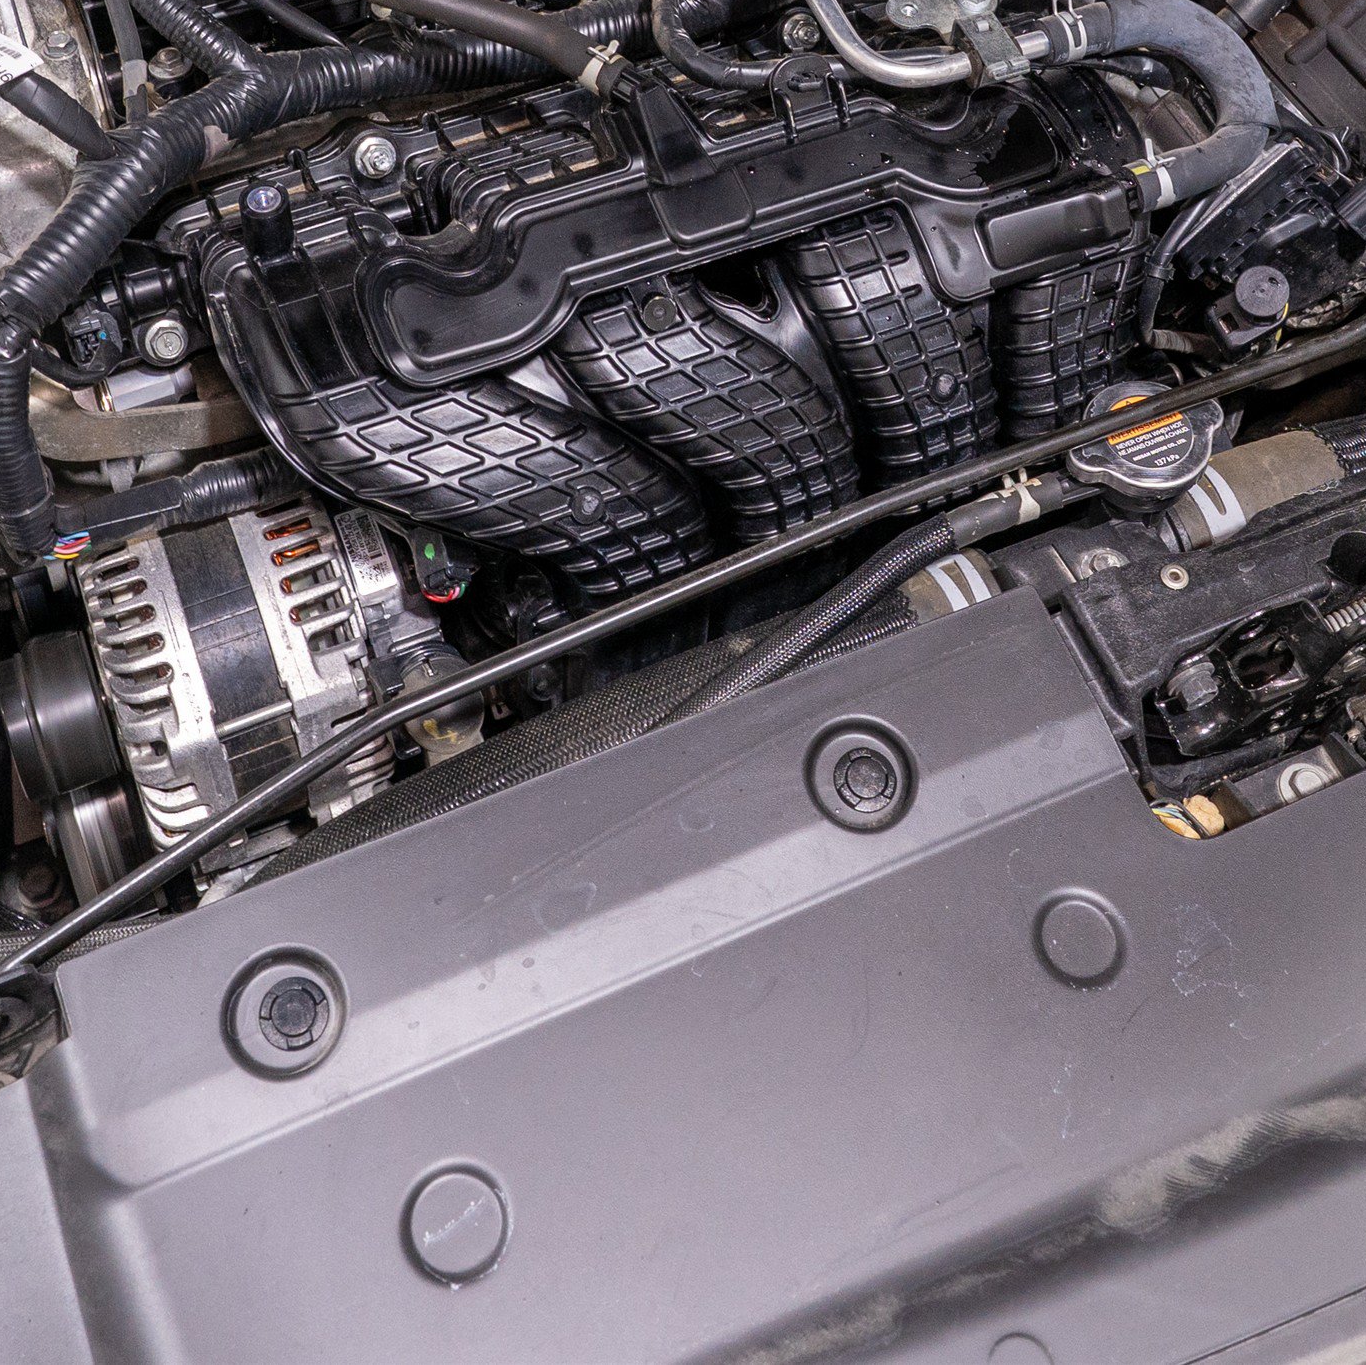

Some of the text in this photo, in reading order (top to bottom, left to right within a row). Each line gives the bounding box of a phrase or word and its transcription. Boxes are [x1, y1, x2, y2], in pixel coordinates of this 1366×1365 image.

[1115, 439, 1135, 449] NEVER
[1135, 433, 1151, 442] OPEN
[1151, 426, 1170, 436] WHEN
[1154, 454, 1180, 467] 137 kPa
